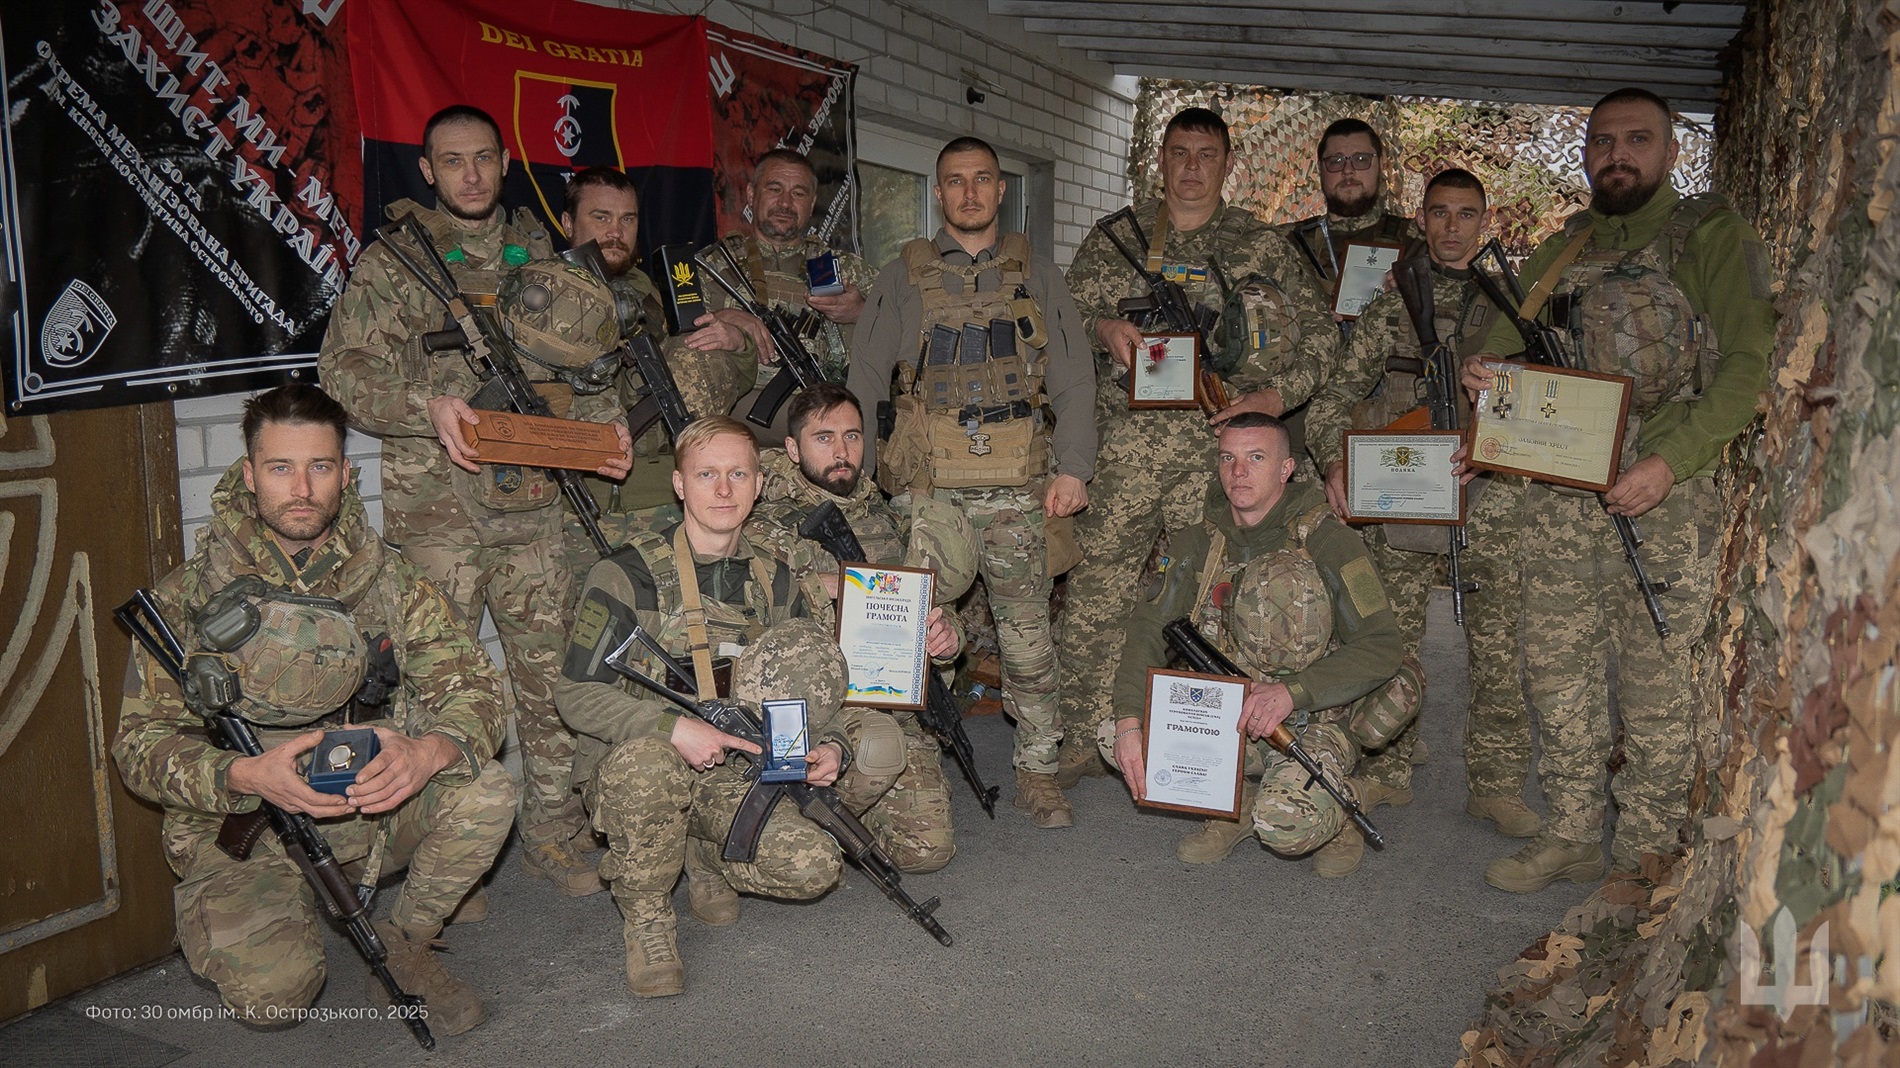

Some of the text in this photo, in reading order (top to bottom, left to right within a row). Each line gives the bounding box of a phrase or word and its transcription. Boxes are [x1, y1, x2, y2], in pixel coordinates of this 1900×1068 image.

[479, 21, 643, 68] DEI GRATIA
[91, 0, 349, 296] ЗАХИСТ УКРАЇН
[227, 95, 287, 169] МИ
[36, 40, 296, 336] ОКРЕМА МЕХАНІЗОВАНА БРИГАДА
[159, 158, 202, 212] 30-ТА
[67, 106, 113, 158] КНЯЗЯ
[110, 153, 190, 244] КОСТЯНТИНА
[190, 240, 264, 325] ОСТРОЗЬКОГО
[74, 282, 113, 325] DEI GRATIA
[866, 602, 909, 613] ПОЧЕСНА
[866, 612, 907, 622] ГРАМОТА
[1166, 723, 1220, 737] ГРАМОТОЮ
